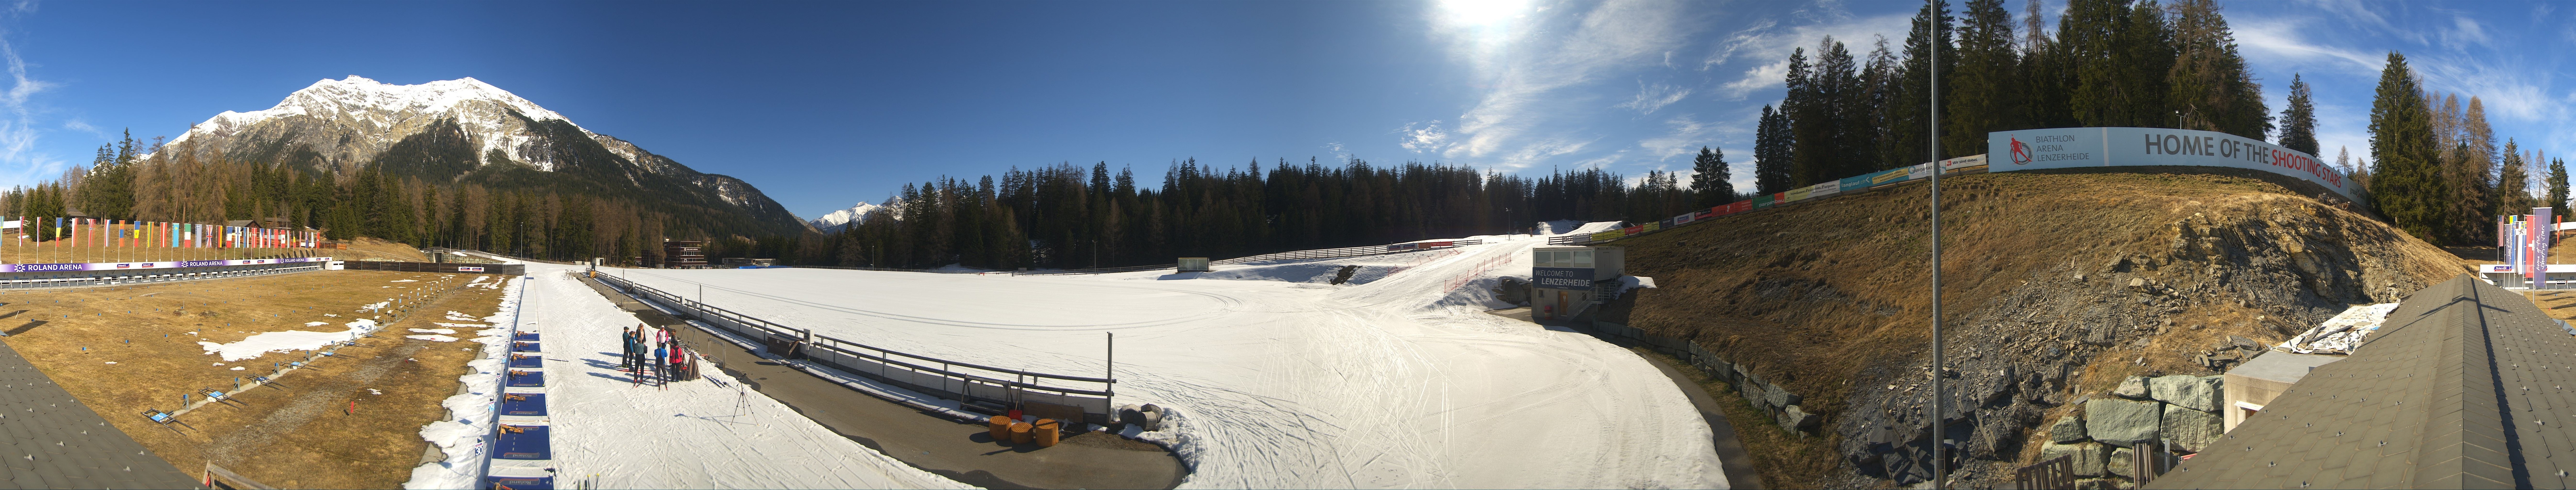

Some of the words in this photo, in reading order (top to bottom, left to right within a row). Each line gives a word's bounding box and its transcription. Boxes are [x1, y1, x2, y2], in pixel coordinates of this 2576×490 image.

[2038, 153, 2089, 161] LENZERHEIDE
[2145, 134, 2214, 156] HOME
[2221, 139, 2240, 159] OF
[2244, 143, 2268, 164] THE
[2272, 149, 2320, 177] SHOOTING
[2323, 167, 2341, 188] STARS
[1759, 199, 1784, 207] parpanbau
[1541, 278, 1590, 287] LENZERHEIDE
[475, 446, 483, 455] 30
